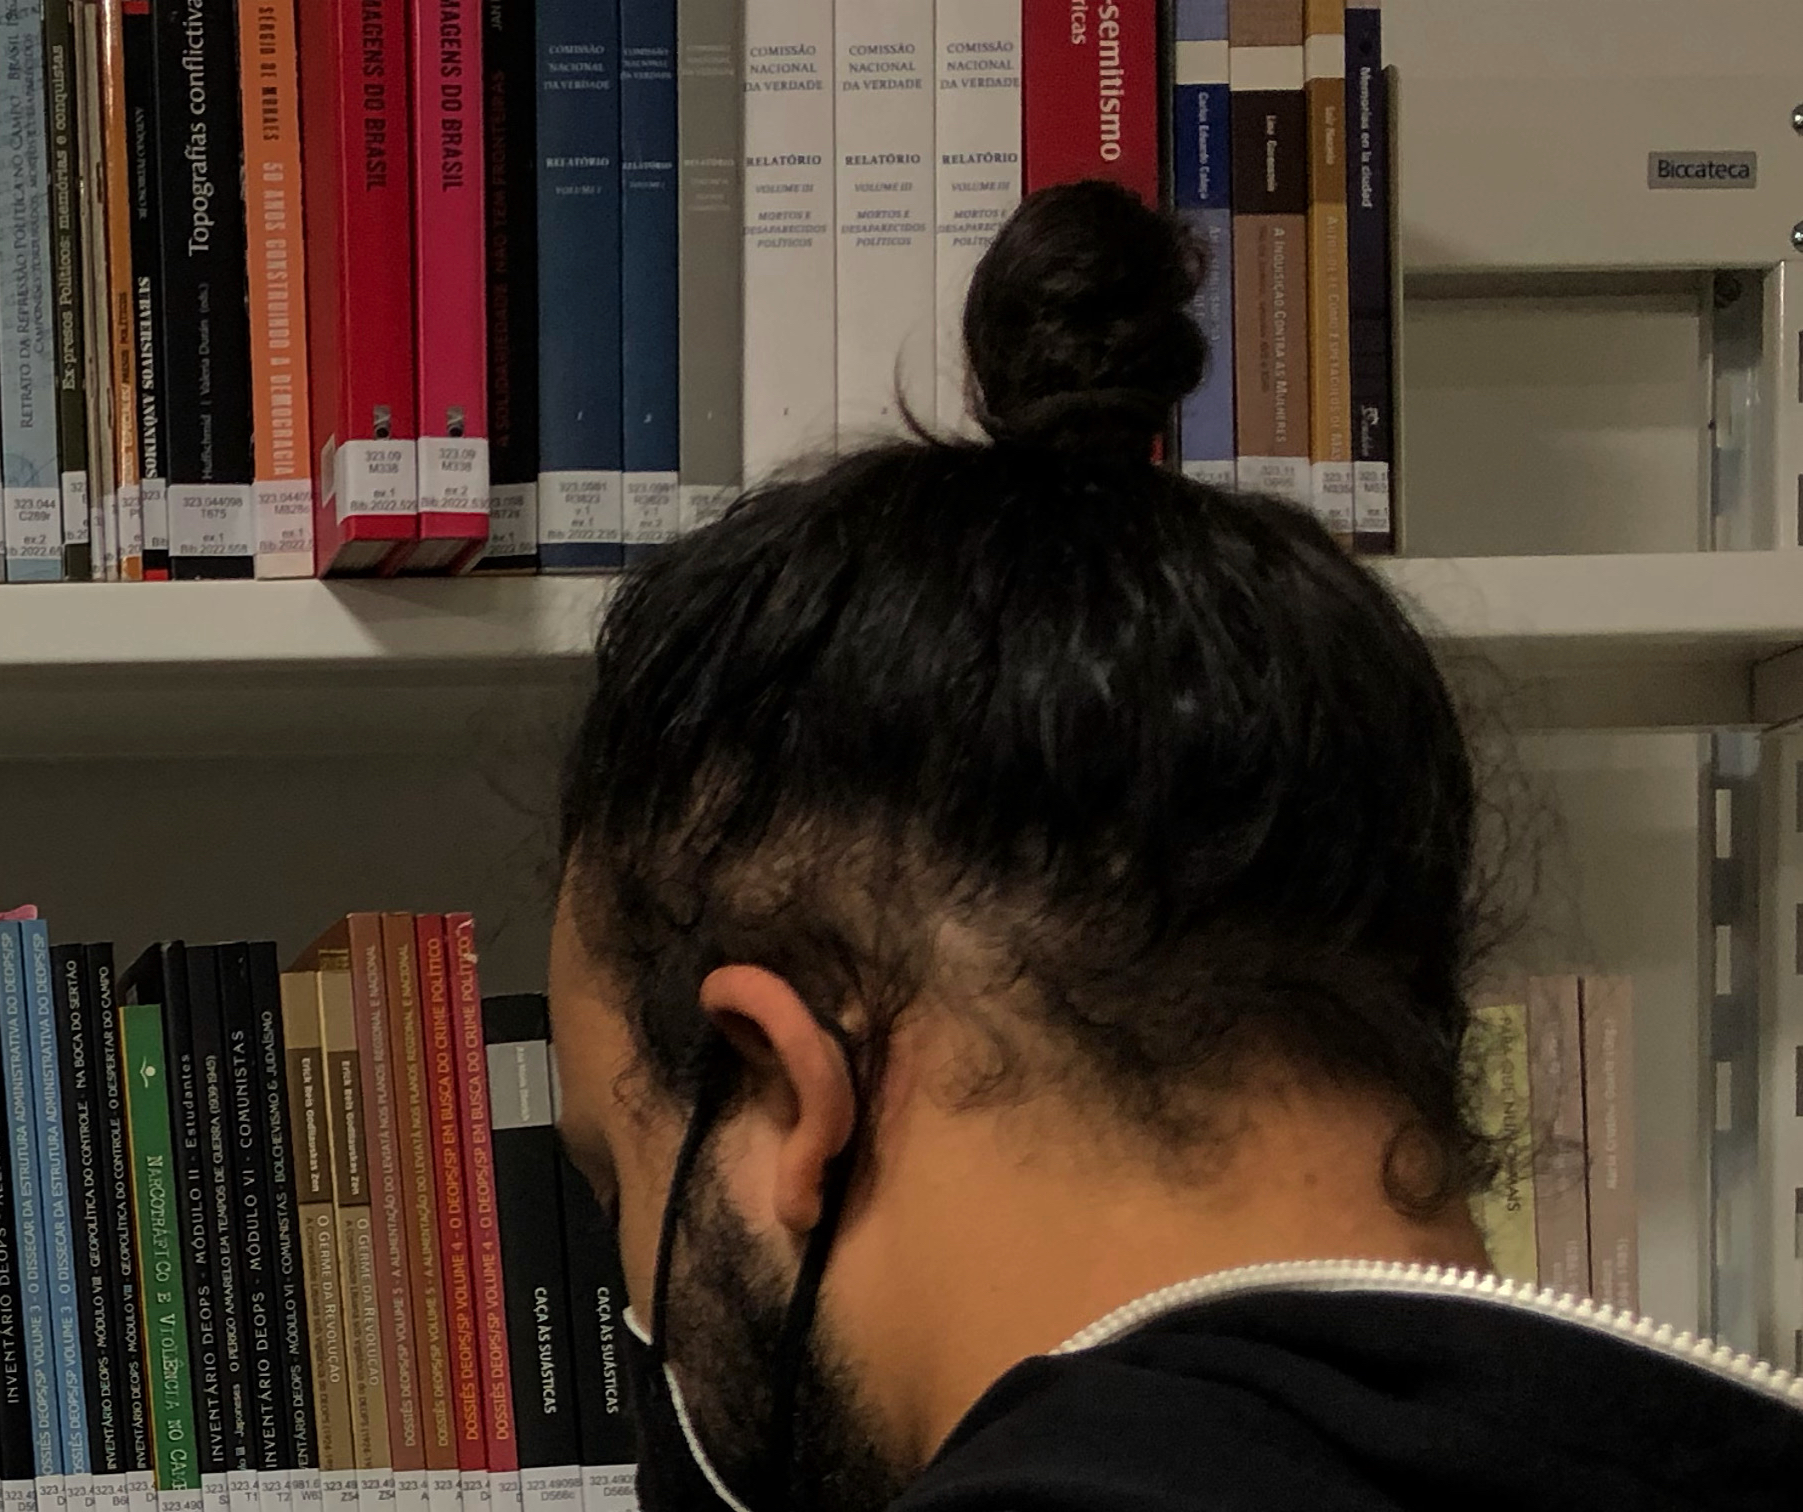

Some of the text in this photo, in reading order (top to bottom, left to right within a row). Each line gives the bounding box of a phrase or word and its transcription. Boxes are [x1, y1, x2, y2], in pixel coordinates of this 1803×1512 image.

[54, 45, 67, 130] conquistas
[842, 79, 922, 92] DA VERDADE
[849, 42, 916, 56] COMISSÃO
[849, 61, 916, 73] NACIONAL
[56, 151, 69, 229] memórias
[364, 84, 387, 191] DO BRASIL
[440, 84, 463, 192] DO BRASIL
[846, 152, 921, 166] RELATÓRIO
[1360, 67, 1373, 208] Memorias en la ciudad
[1657, 159, 1750, 180] Biccateca
[59, 235, 73, 305] Políticos:
[262, 162, 295, 475] 50 ANOS CONSTRUINDO A DEMOCRACIA
[138, 277, 159, 478] SUBVERSIVOS ANÔNIMOS
[426, 939, 478, 1440] DOSSIÊS DEOPS/SP VOLUME DEOPS/SP EM BUSCA DO CRIME POLÍTICO
[146, 1155, 185, 1440] NARCOTRÁFICO VIOLÊNCIA NO
[232, 1030, 277, 1468] INVENTÁRIO DEOPS MÓDULO VI COMUNISTAS
[0, 1294, 19, 1403] INVENTÁRIO
[533, 1288, 556, 1414] CAÇA ÀS SUÁSTICAS
